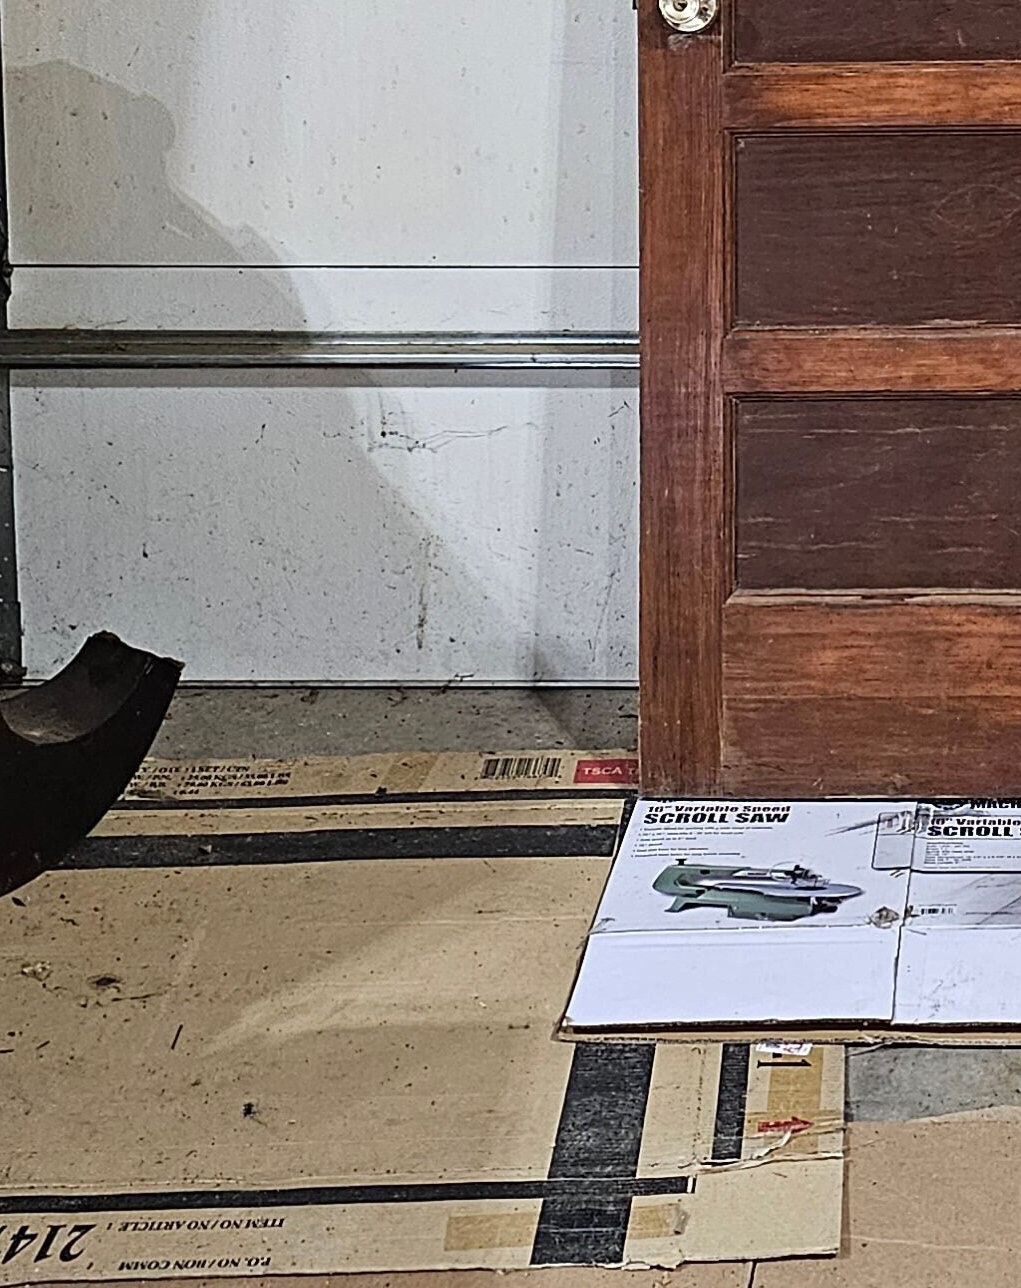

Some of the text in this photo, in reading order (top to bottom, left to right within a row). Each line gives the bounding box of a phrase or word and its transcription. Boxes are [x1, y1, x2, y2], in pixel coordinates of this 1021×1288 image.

[582, 766, 623, 775] TSCA
[643, 812, 790, 824] SCROLL SAW
[956, 818, 1021, 826] Variable
[927, 826, 1014, 837] SCROLL
[118, 1220, 186, 1232] ARTICLE
[244, 1218, 285, 1229] ITEM
[0, 1224, 97, 1263] 214
[118, 1260, 171, 1271] COMM
